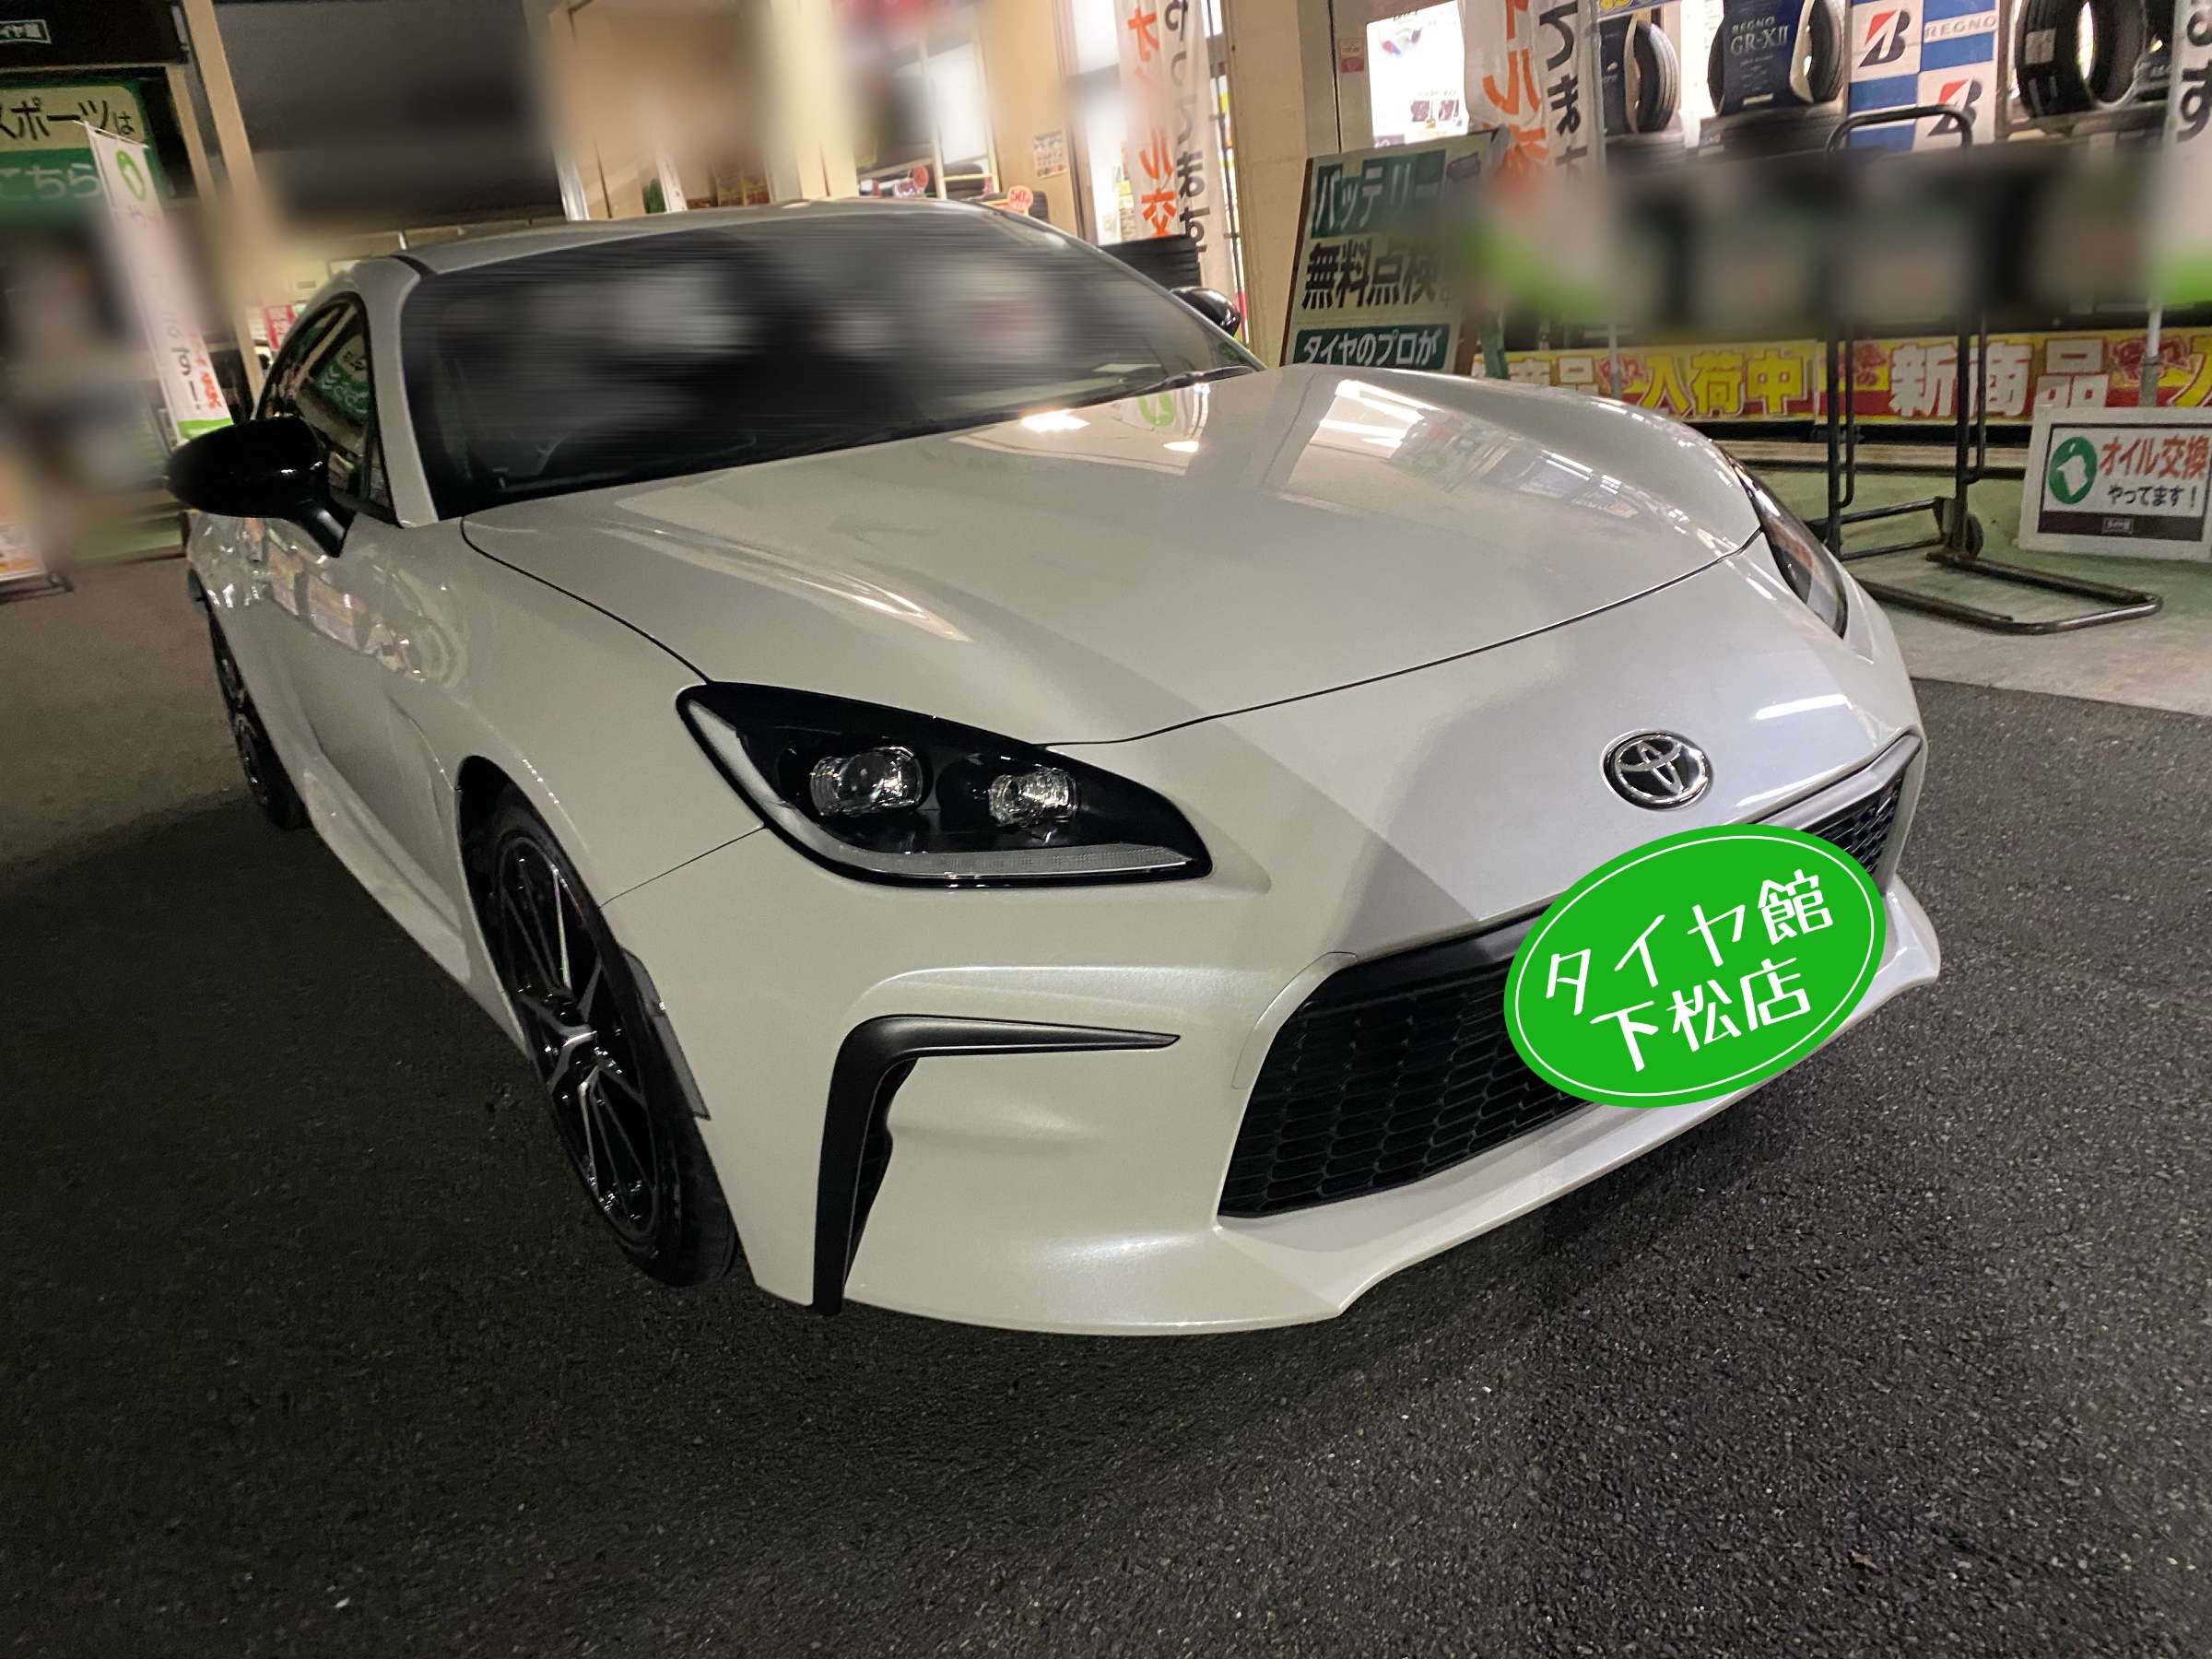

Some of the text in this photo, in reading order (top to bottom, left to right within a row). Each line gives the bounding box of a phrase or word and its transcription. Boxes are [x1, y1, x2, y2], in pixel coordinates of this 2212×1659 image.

[1924, 15, 1998, 39] REGNO
[1303, 327, 1443, 366] タイヤのプロが
[1639, 350, 1805, 416] 入荷中
[2099, 435, 2209, 480] オイル交換
